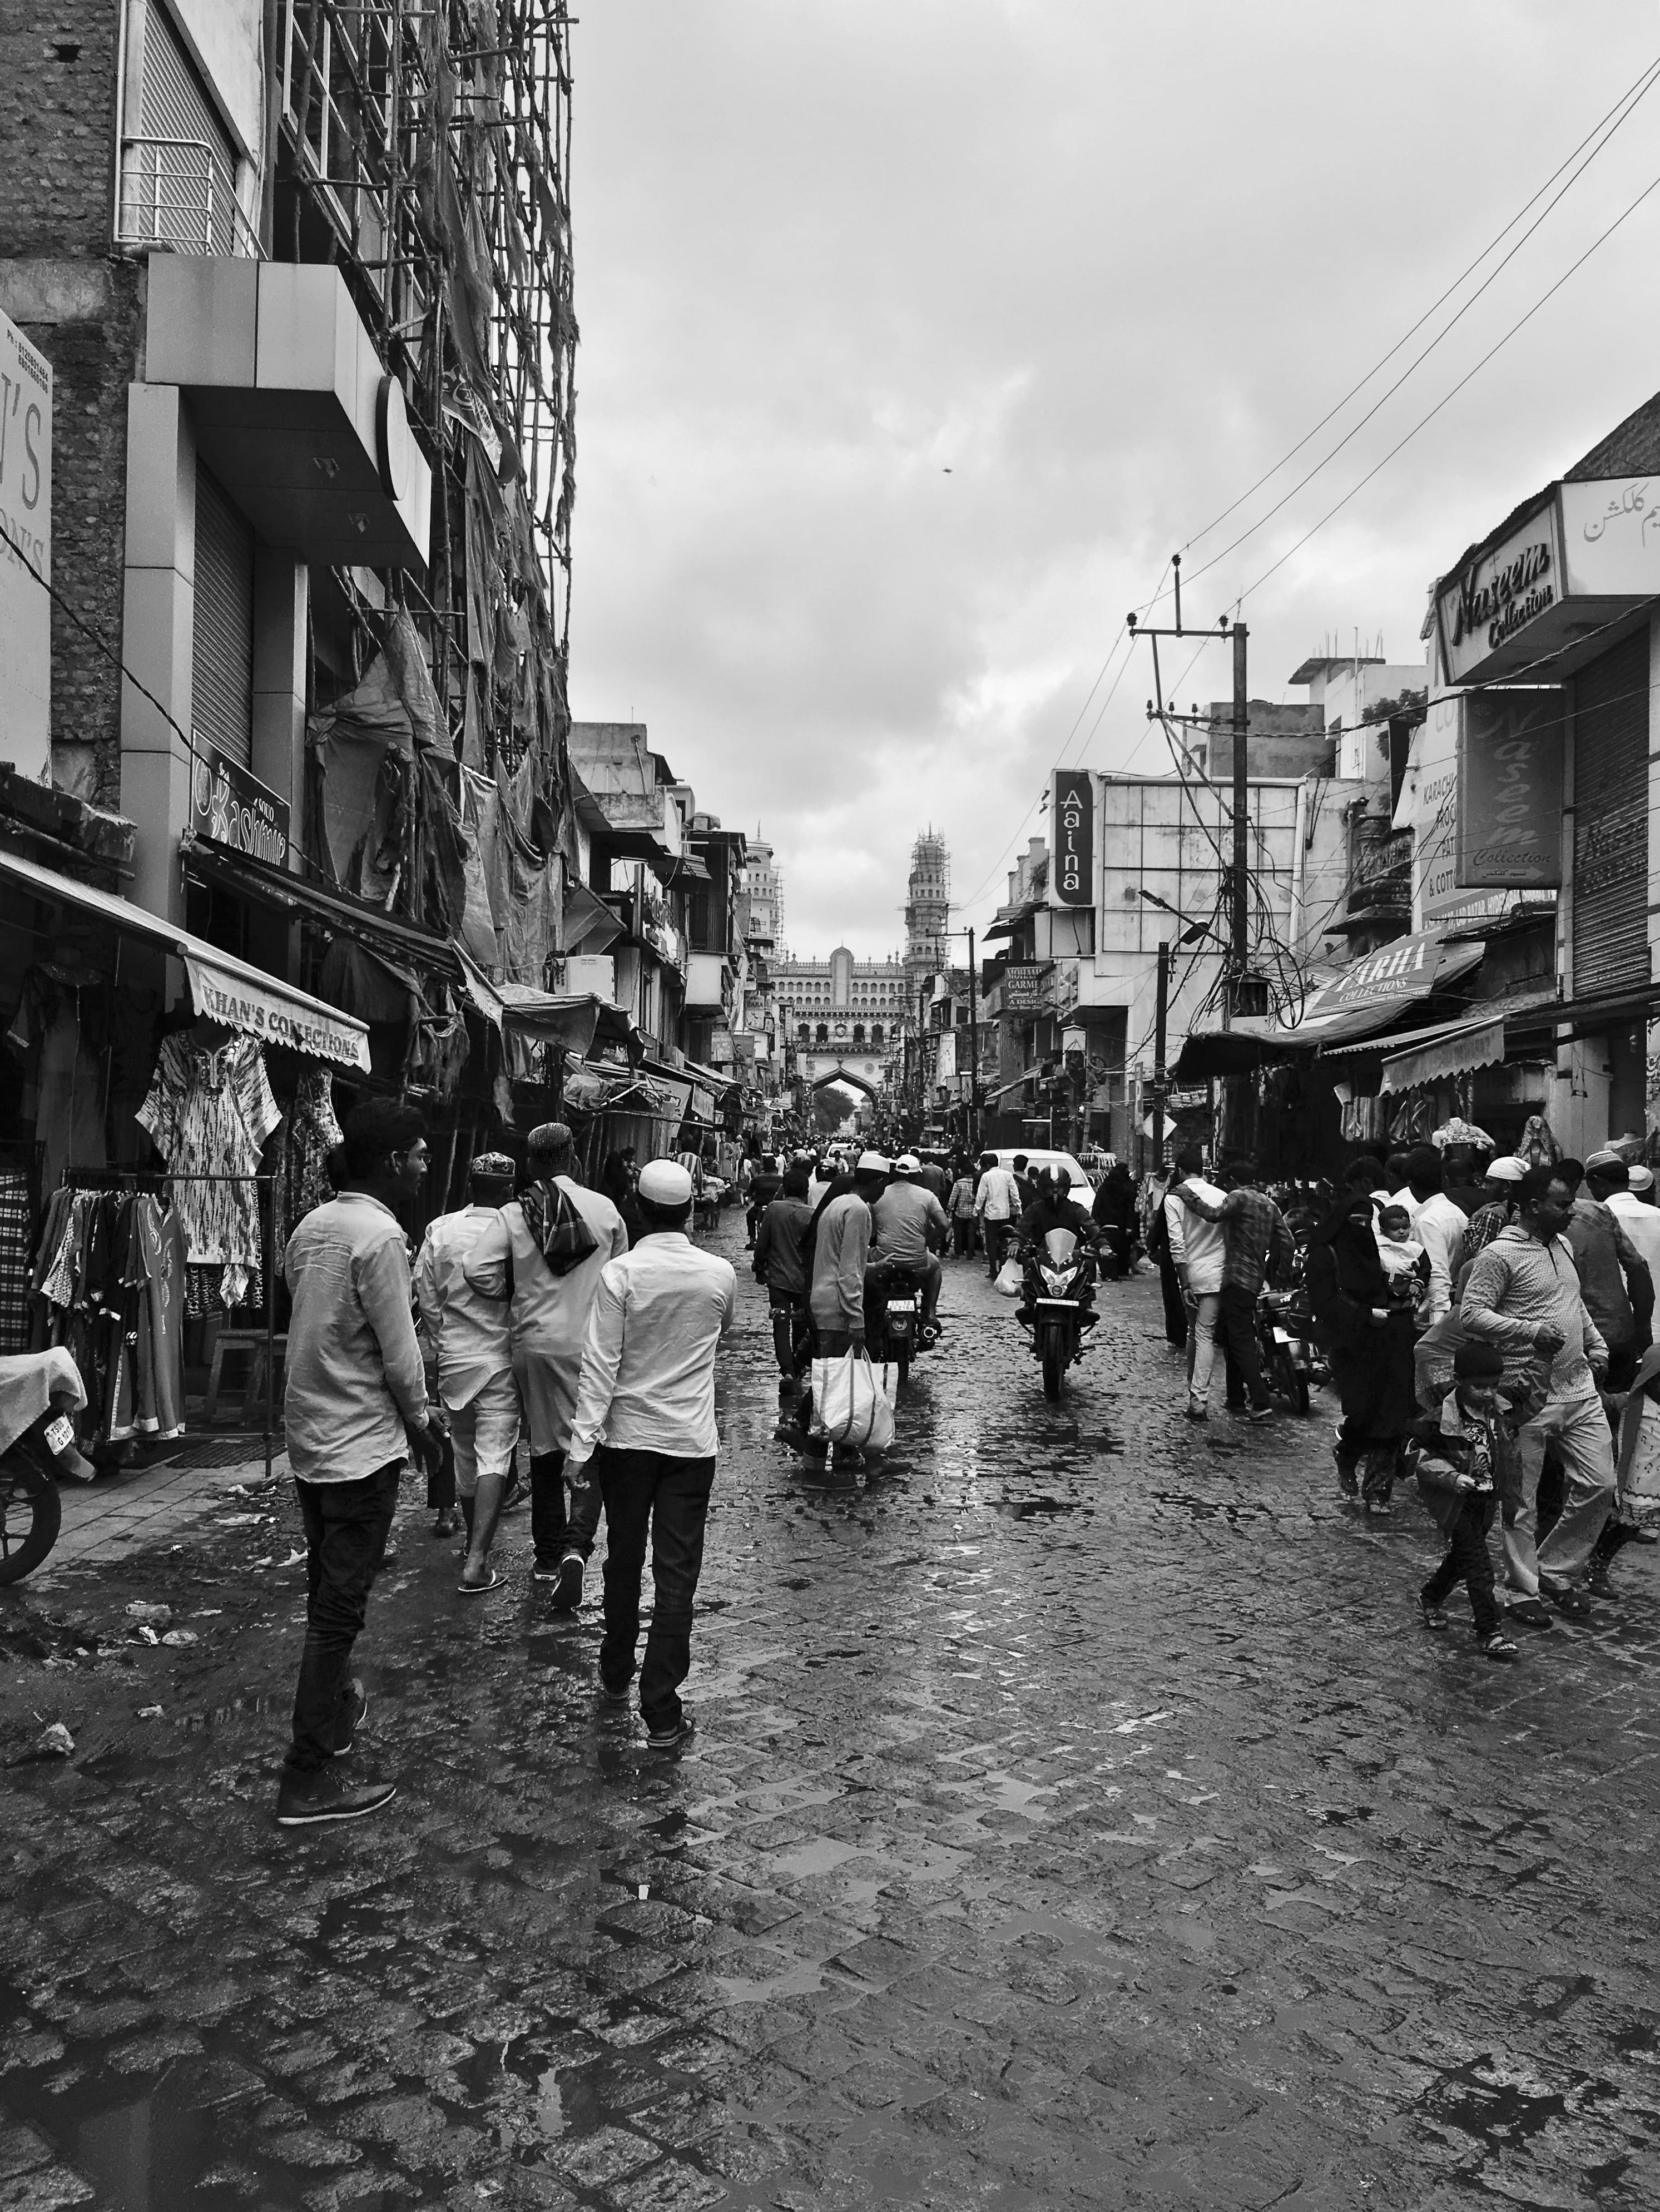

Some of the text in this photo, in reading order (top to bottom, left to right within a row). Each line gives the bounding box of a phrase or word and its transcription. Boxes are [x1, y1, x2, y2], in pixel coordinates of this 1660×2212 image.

[1451, 543, 1550, 647] Naseem
[1488, 584, 1553, 649] Collection
[1060, 790, 1083, 890] Aaina
[1473, 849, 1552, 866] Collection
[1335, 942, 1425, 992] FARHA
[1339, 977, 1408, 1003] COLLECTIONS
[202, 984, 265, 1029] KHAN'S
